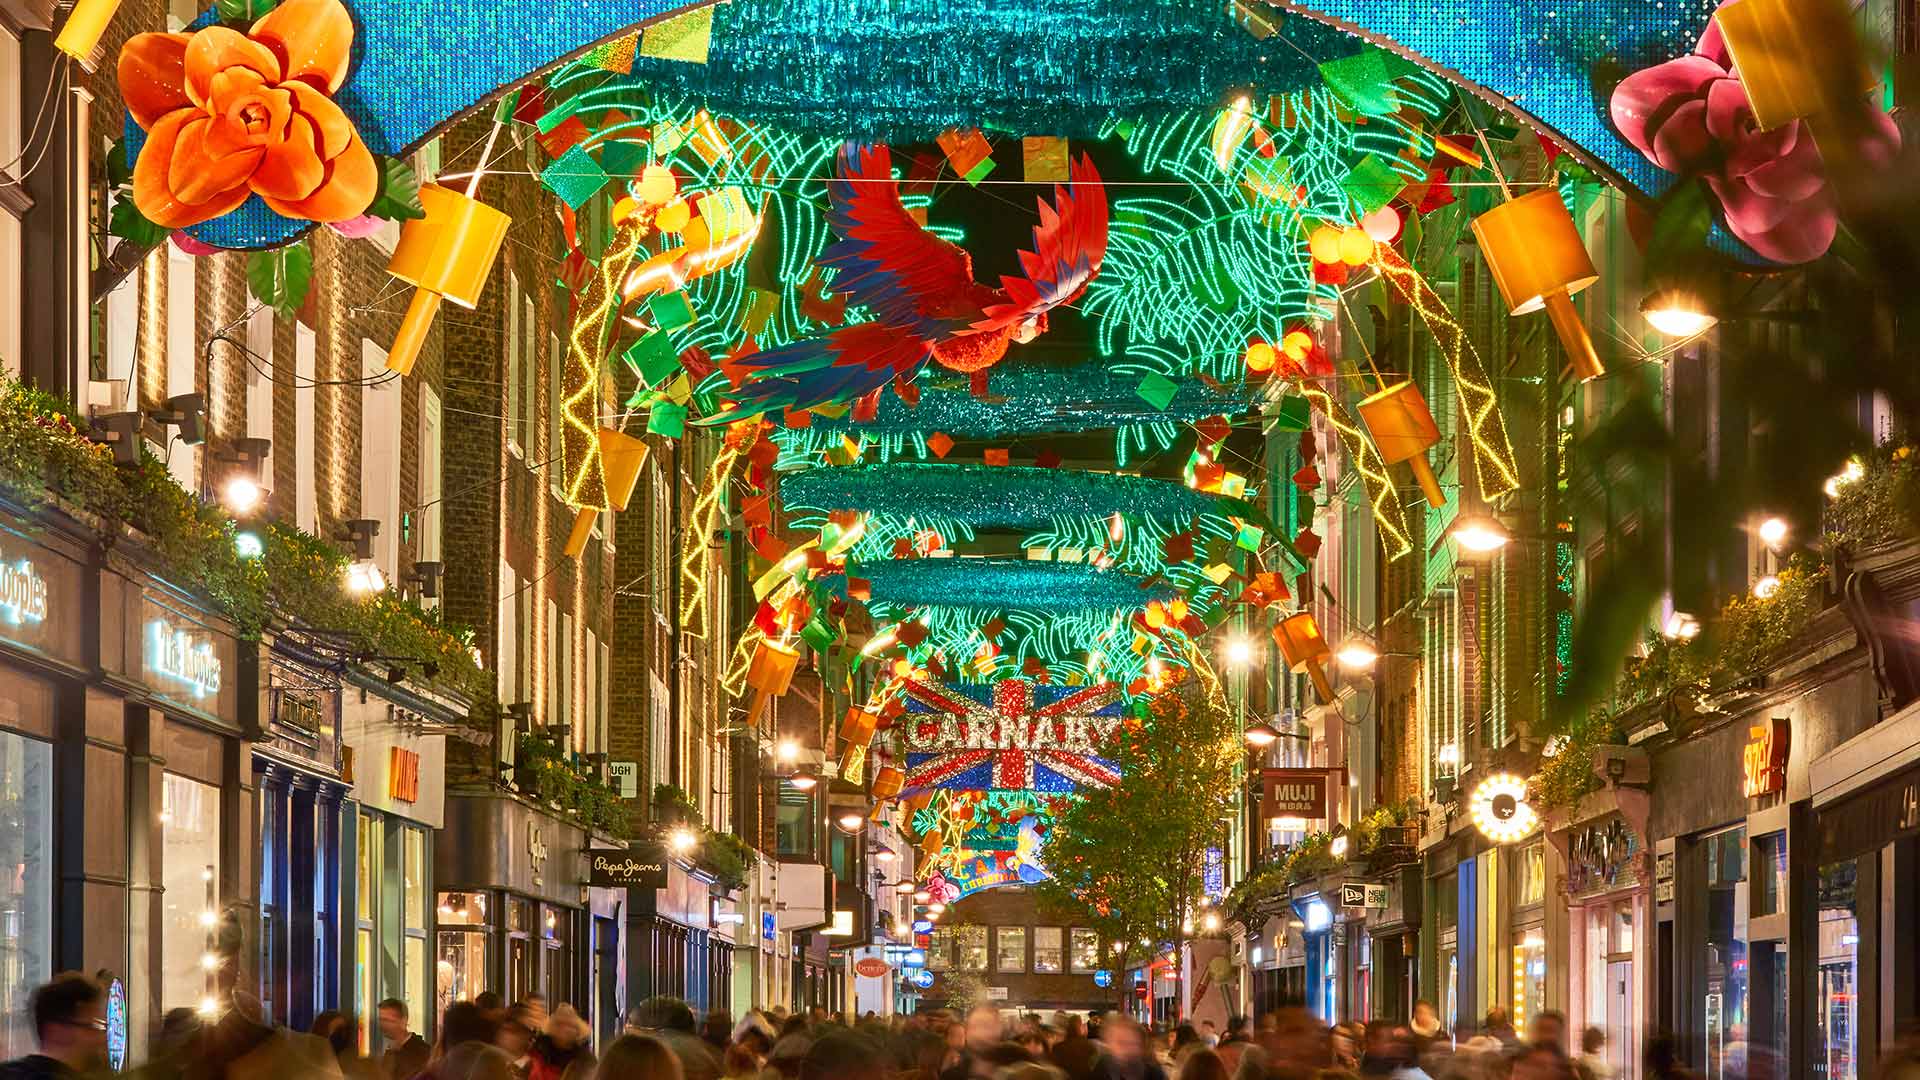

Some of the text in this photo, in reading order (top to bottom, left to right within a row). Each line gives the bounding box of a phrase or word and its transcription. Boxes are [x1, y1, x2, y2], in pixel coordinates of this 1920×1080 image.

[0, 560, 47, 624] ooples
[905, 712, 1120, 750] CARNABY
[1275, 784, 1316, 801] MUJI
[594, 856, 661, 877] Pepe Jeans
